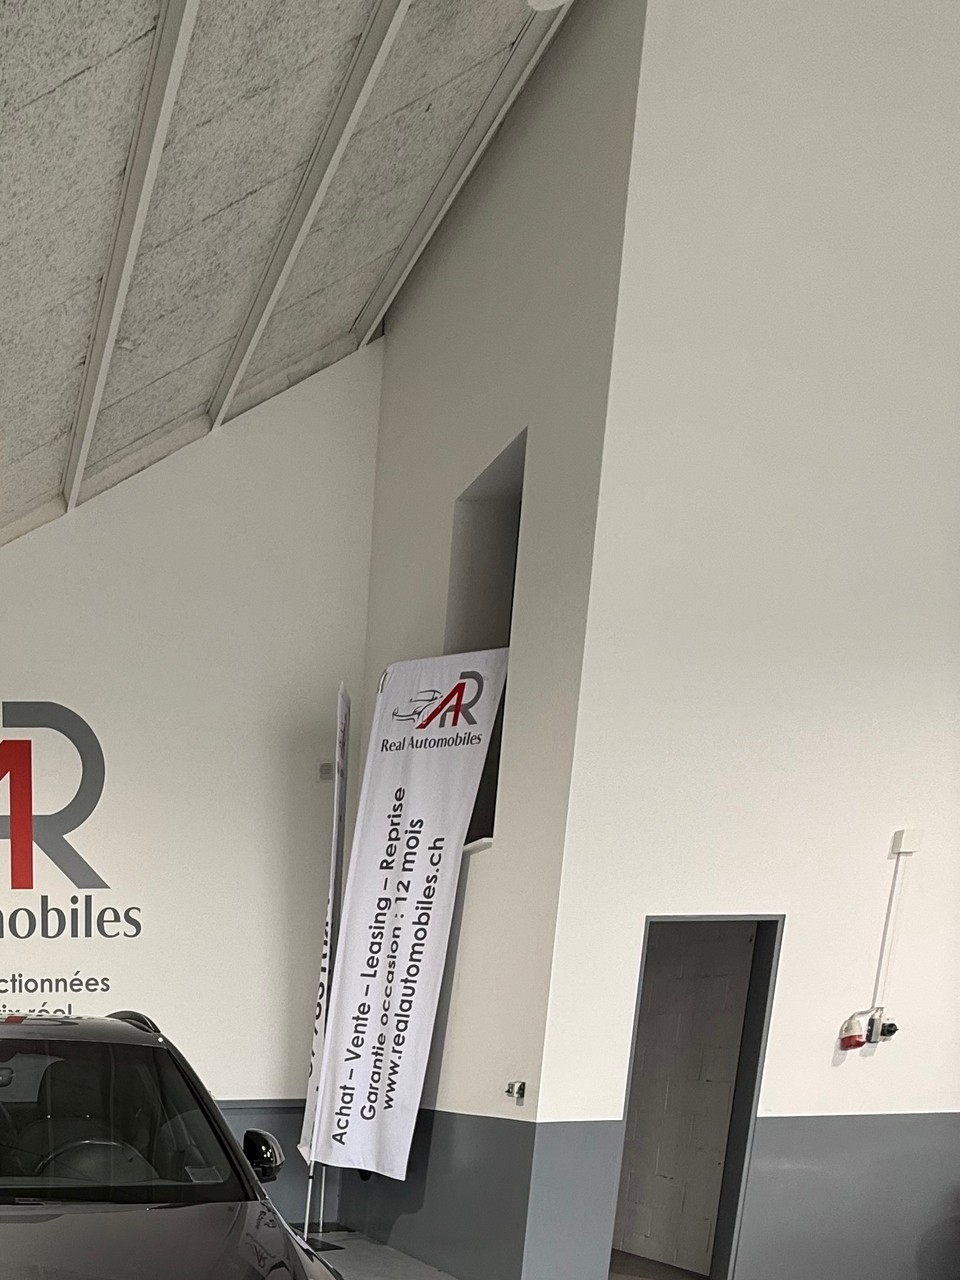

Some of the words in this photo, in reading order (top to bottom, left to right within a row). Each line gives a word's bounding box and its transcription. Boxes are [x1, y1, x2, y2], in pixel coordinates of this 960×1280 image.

[380, 737, 406, 753] Real
[407, 731, 483, 750] Automobiles
[379, 786, 406, 871] Reprise
[400, 818, 424, 873] mois
[394, 879, 412, 905] 12
[360, 897, 393, 979] Leasing
[383, 837, 446, 1111] www.realautomobiles.ch
[380, 927, 402, 1027] occasion
[343, 1002, 371, 1063] Vente
[359, 1032, 387, 1121] Garantie
[331, 1084, 356, 1146] Achat
